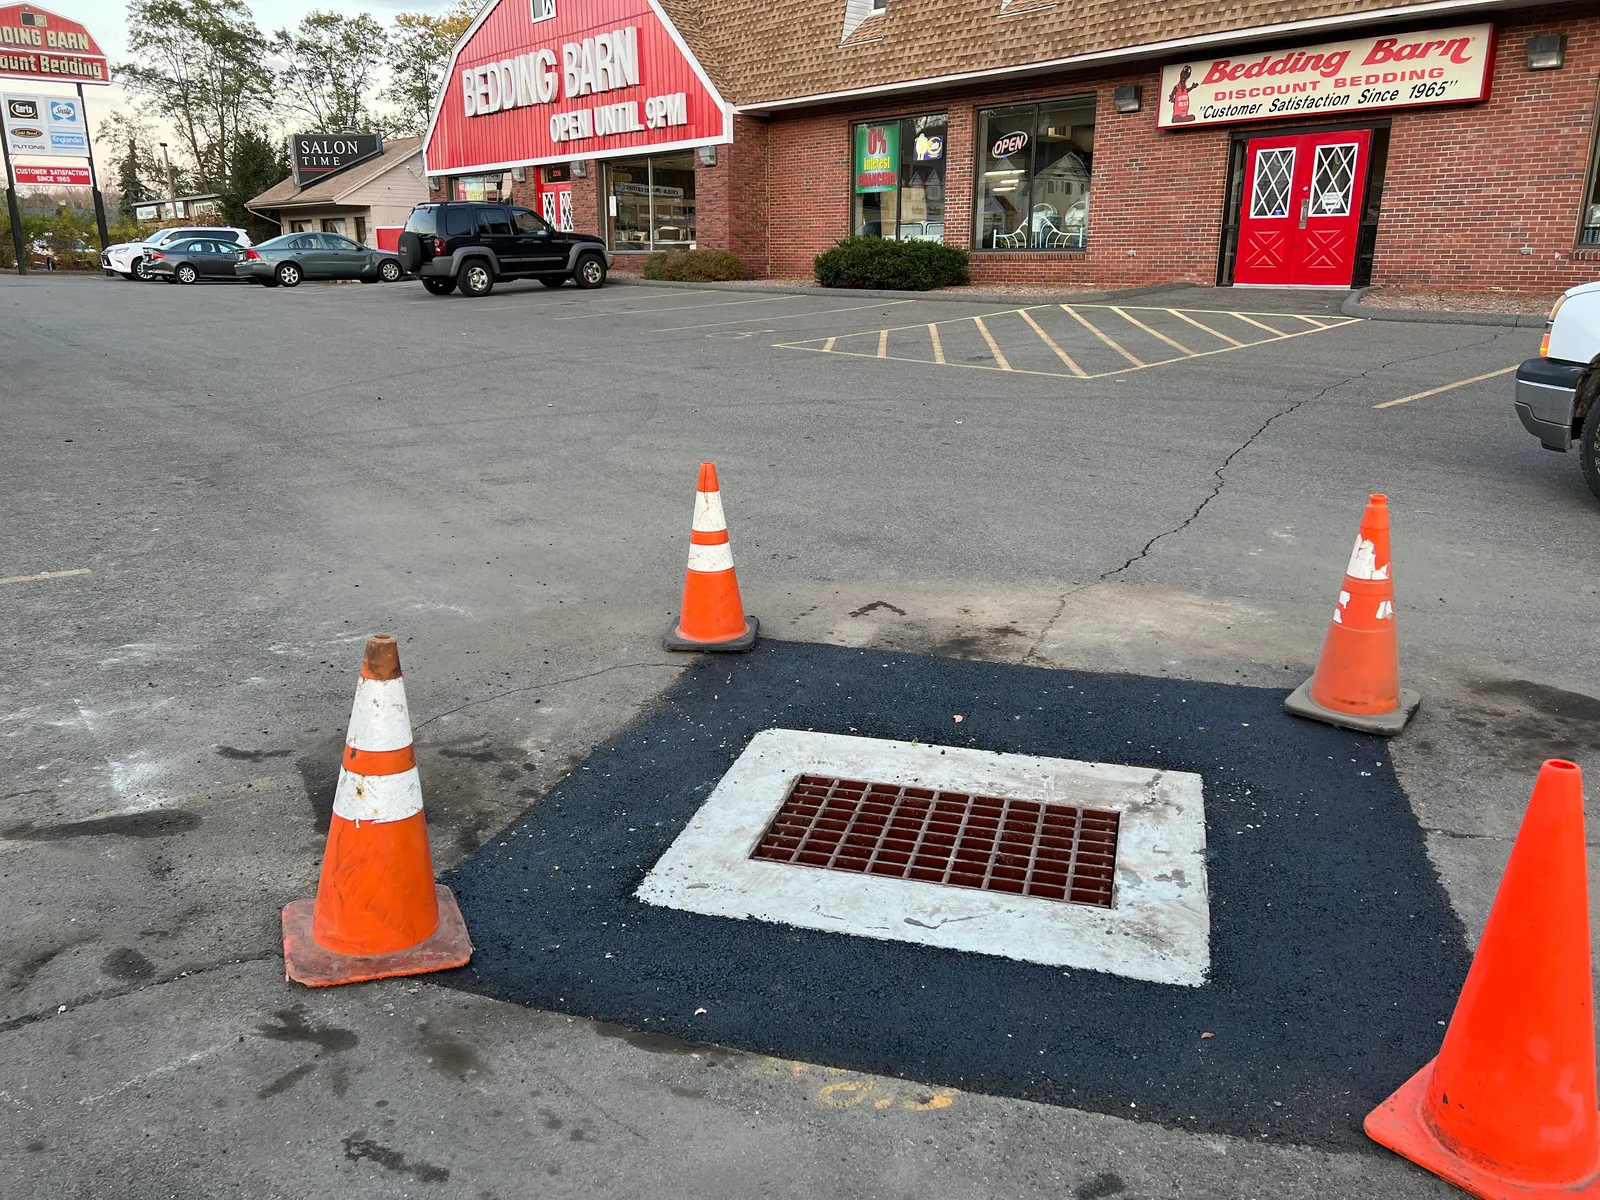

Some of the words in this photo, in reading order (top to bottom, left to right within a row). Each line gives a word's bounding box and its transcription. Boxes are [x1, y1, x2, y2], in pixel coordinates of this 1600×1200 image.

[46, 30, 89, 51] BARN
[39, 54, 103, 80] Bedding
[462, 48, 558, 118] BEDDING
[562, 26, 640, 98] BARN
[1200, 50, 1351, 86] Bedding
[1361, 36, 1473, 67] Barn
[1213, 80, 1321, 102] DISCOUNT
[1333, 67, 1446, 89] BEDDING
[15, 104, 33, 114] Serta
[56, 106, 72, 116] Sealy
[1269, 88, 1350, 114] Satisfaction
[1358, 86, 1399, 105] Since
[550, 109, 593, 143] OPEN
[593, 101, 645, 137] UNTIL
[645, 92, 688, 130] 9PM
[301, 140, 358, 154] SALON
[868, 128, 887, 155] 0%
[994, 134, 1024, 154] OPEN
[302, 156, 341, 166] TIME
[863, 156, 891, 171] Interest
